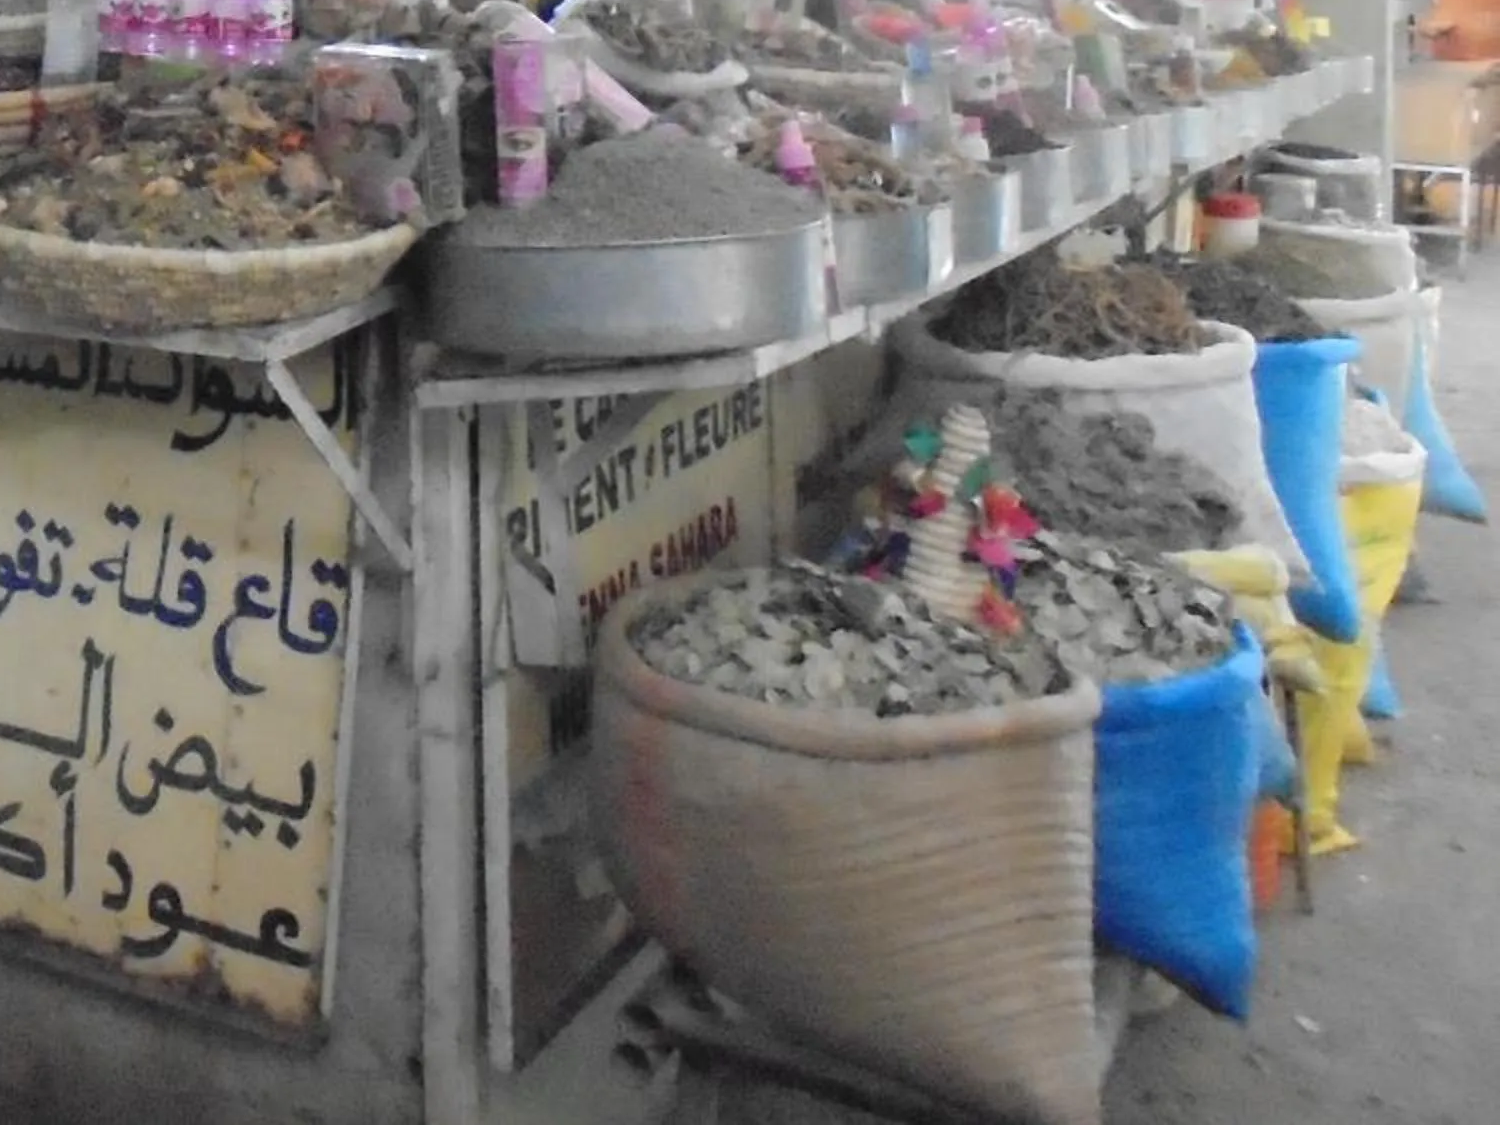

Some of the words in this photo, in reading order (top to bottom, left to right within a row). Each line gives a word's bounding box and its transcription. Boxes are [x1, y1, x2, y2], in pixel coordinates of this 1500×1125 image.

[659, 379, 763, 481] FLEURE
[213, 517, 350, 696] قاع
[116, 706, 316, 849] بيض
[102, 849, 312, 969] عود
